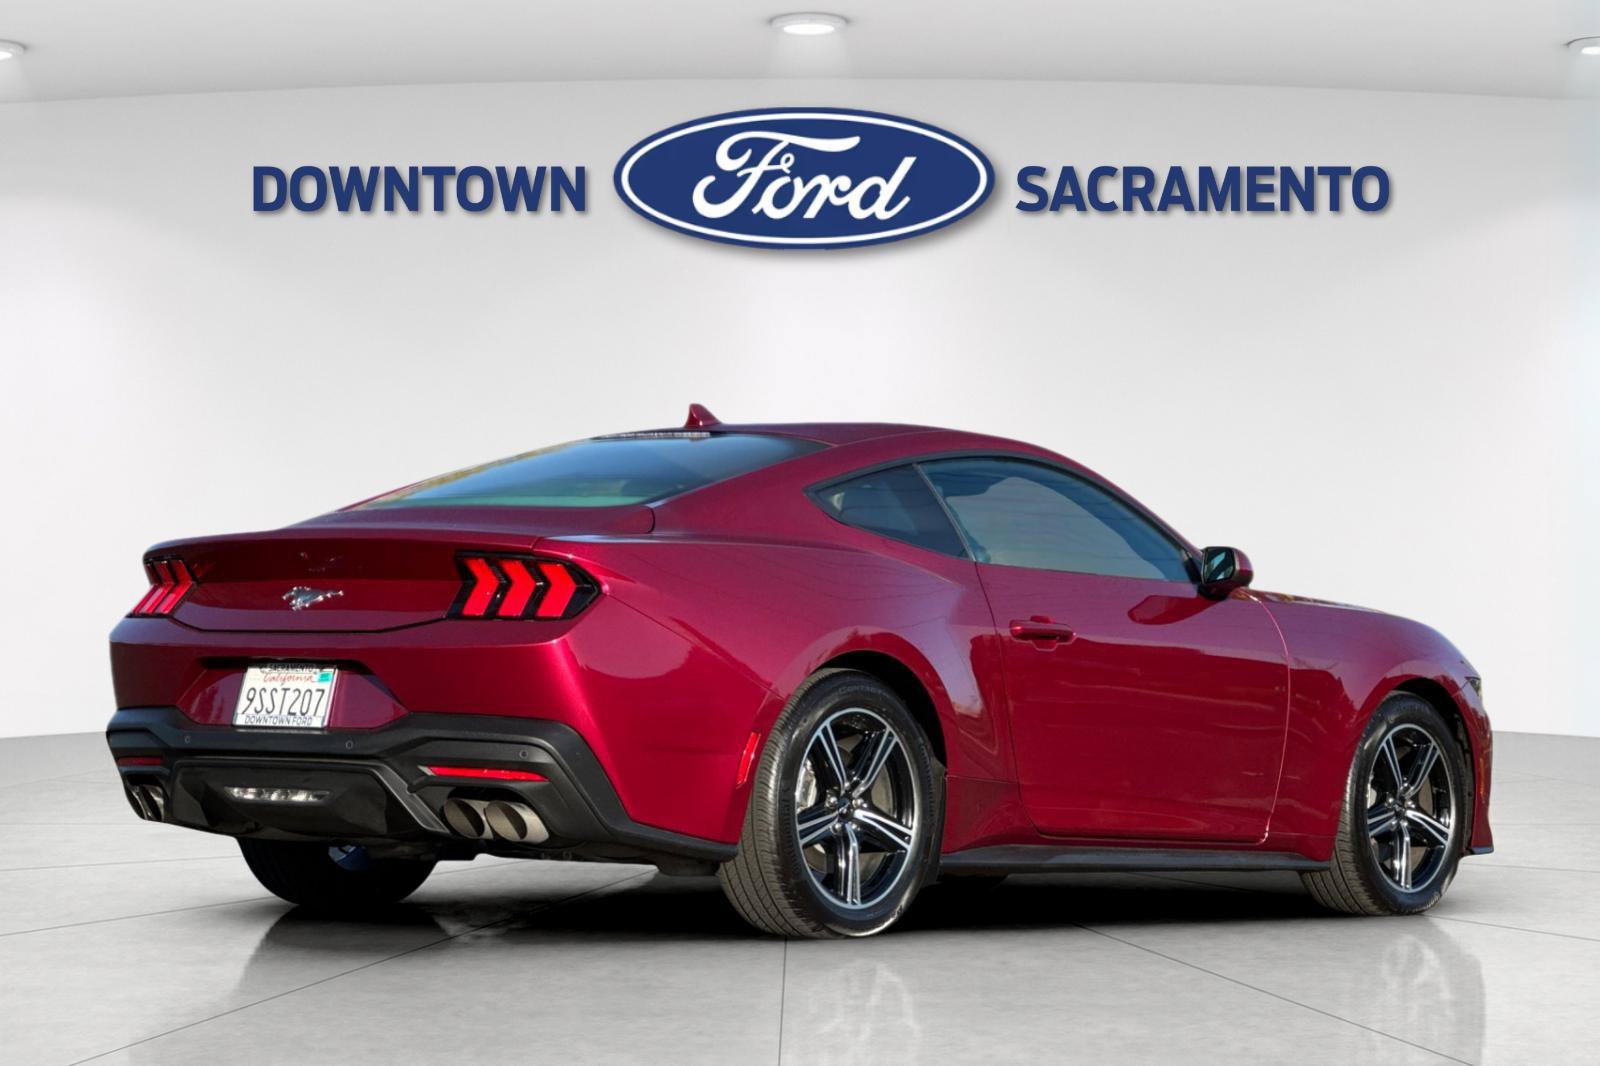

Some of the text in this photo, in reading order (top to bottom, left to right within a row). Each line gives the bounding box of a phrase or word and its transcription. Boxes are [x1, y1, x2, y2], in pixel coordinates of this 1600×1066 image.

[252, 131, 1390, 220] DOWNTOWN Ford SACRAMENTO
[264, 673, 315, 684] California
[242, 687, 325, 717] 9SST207
[245, 715, 313, 726] DOWNTOWN FORD
